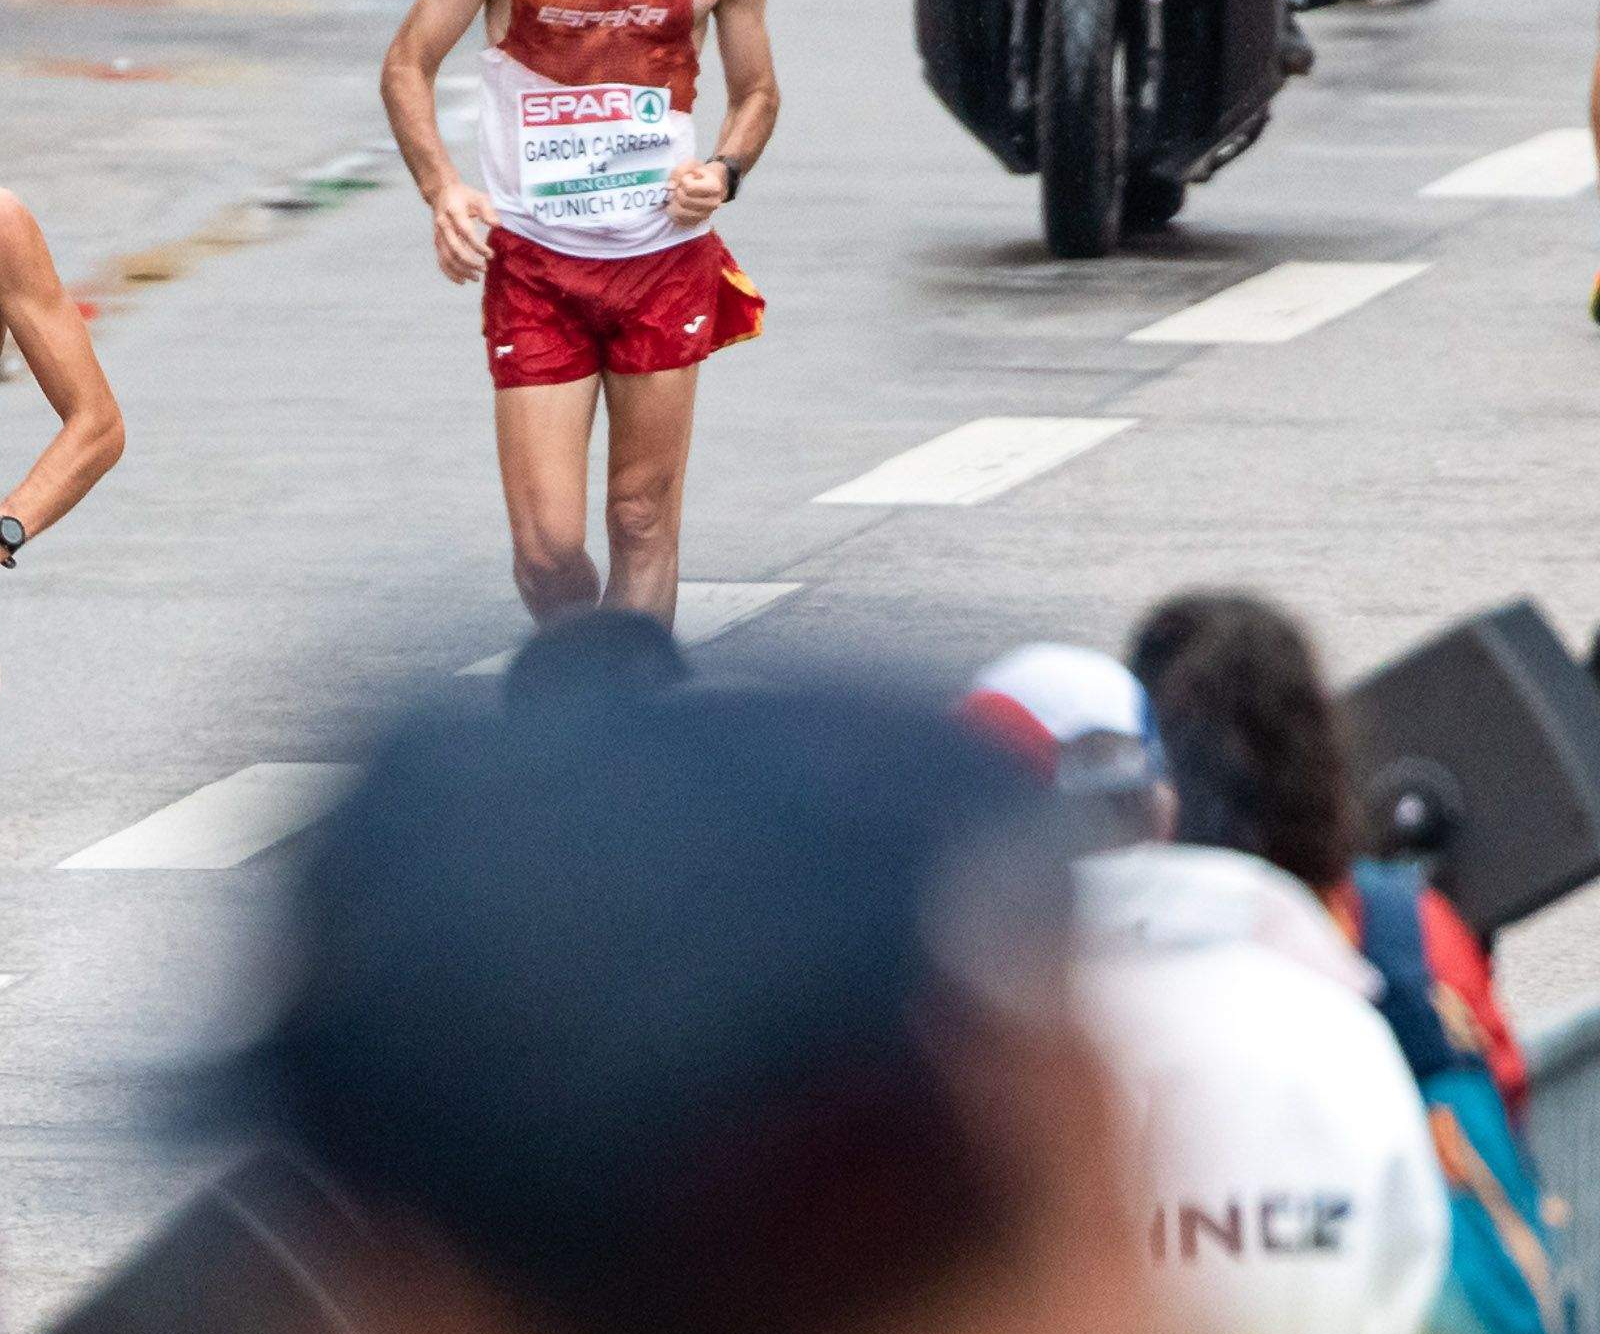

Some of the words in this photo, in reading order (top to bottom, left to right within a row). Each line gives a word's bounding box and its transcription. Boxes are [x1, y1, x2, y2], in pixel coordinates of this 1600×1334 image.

[537, 4, 669, 27] ESPAÑA
[523, 90, 632, 123] SPAR
[524, 133, 587, 162] GARCÍA
[592, 133, 671, 157] CARRERA
[532, 193, 615, 217] MUNICH
